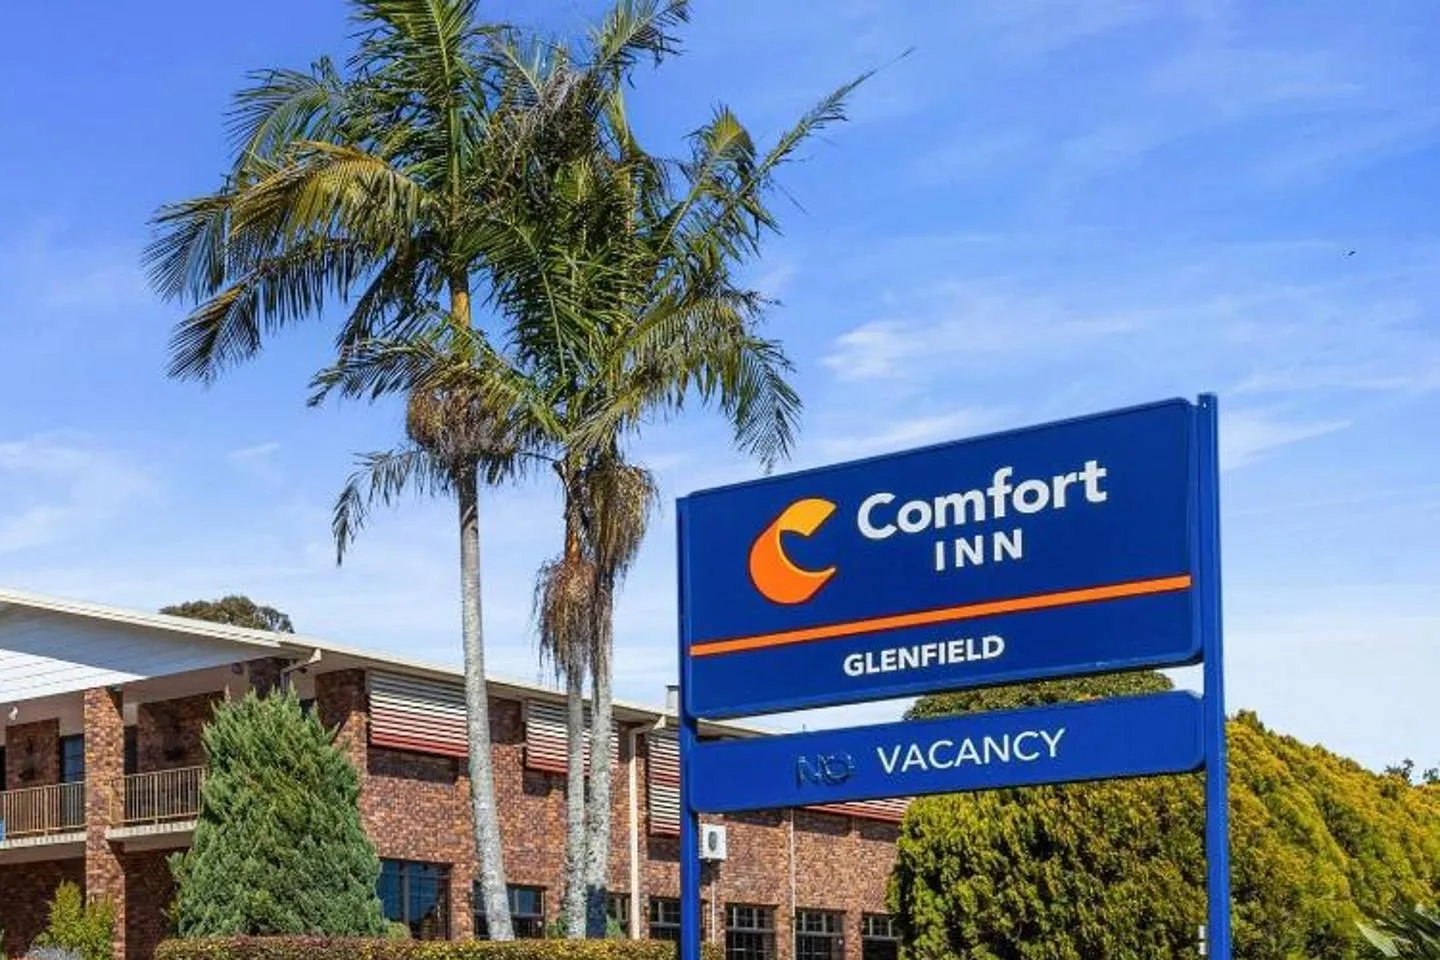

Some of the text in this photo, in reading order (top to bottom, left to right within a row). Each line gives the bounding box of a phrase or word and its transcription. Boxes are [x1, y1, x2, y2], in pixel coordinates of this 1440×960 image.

[857, 460, 1107, 540] Comfort
[935, 529, 1023, 571] INN
[843, 635, 1004, 676] GLENFIELD
[876, 727, 1066, 774] VACANCY
